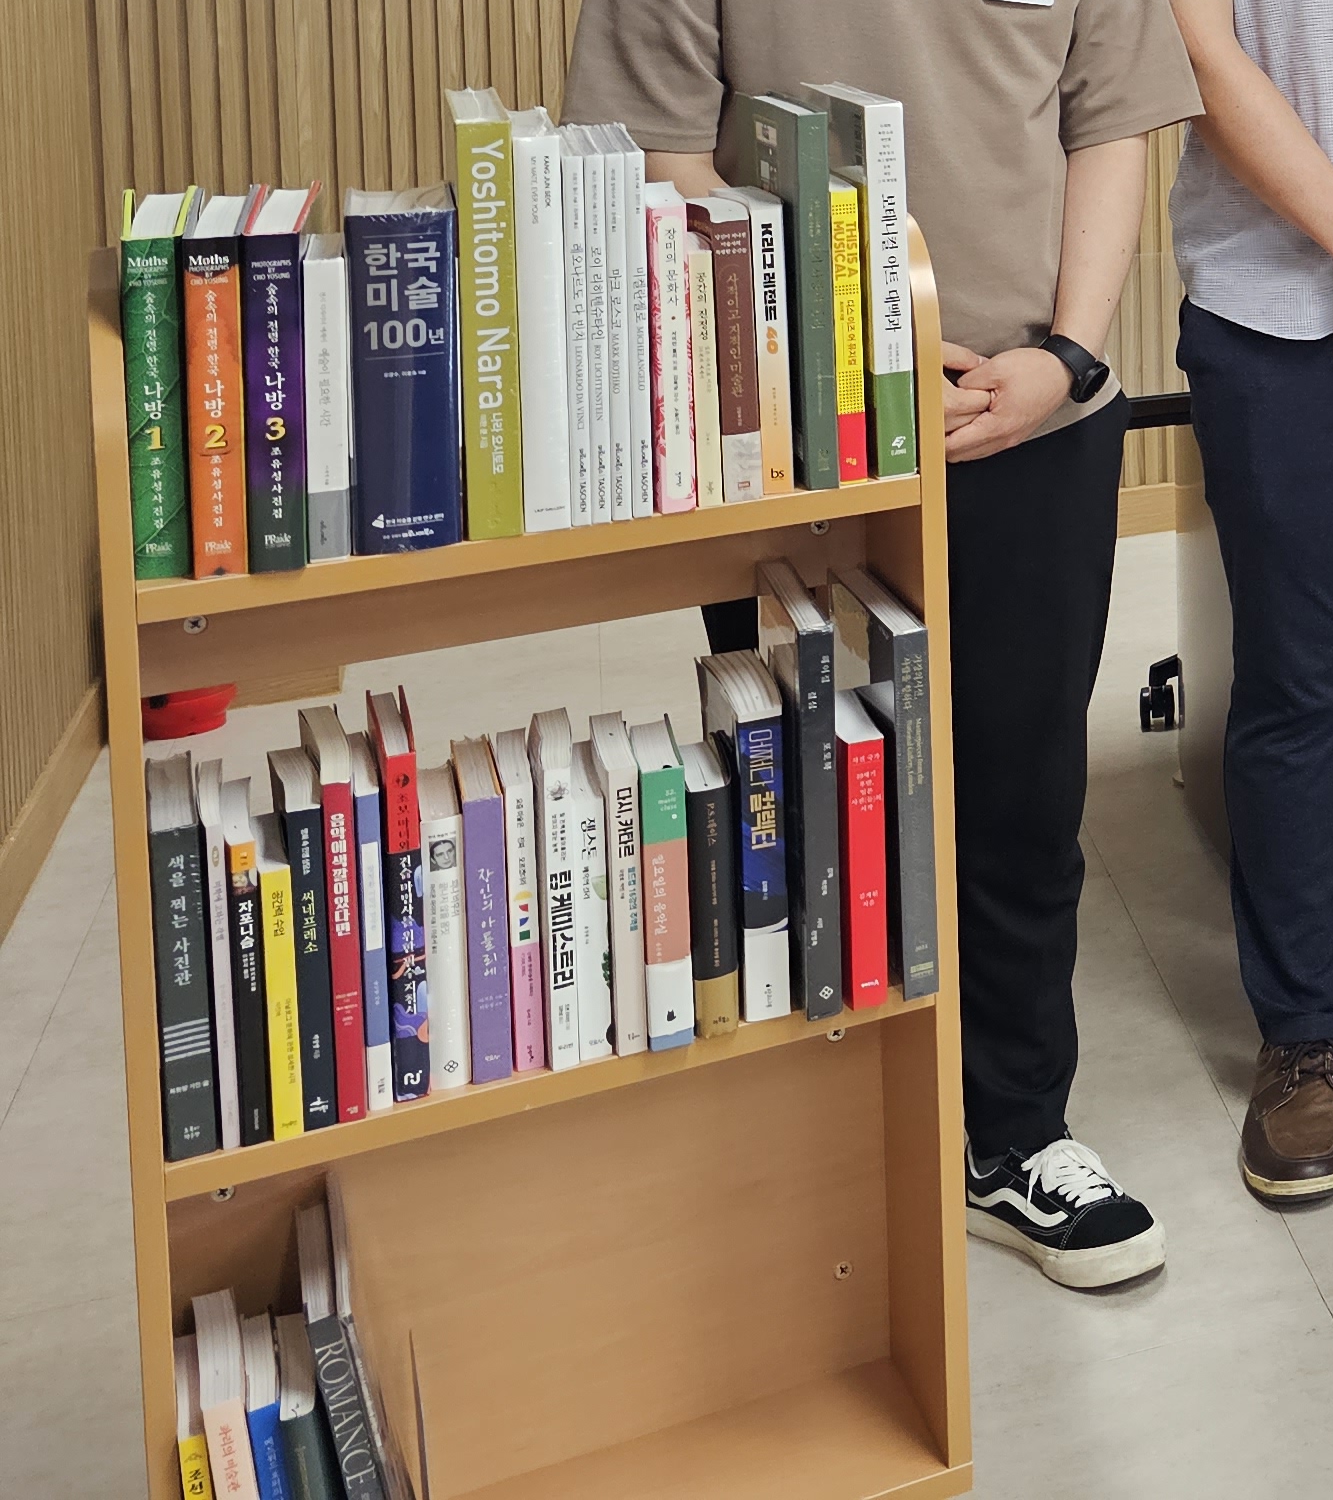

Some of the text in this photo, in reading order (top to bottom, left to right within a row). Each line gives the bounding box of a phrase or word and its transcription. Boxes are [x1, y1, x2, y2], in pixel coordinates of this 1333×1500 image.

[881, 193, 898, 252] 보태니컬
[127, 255, 169, 268] Moths
[188, 254, 230, 267] Moths
[364, 241, 441, 276] 한국
[590, 246, 602, 268] 로이
[665, 228, 679, 306] 장미의 문화사
[834, 221, 847, 281] MUSICAL
[846, 221, 858, 278] THIS IS A
[471, 138, 511, 410] Yoshitomo Nara
[570, 243, 584, 299] 레오나르도
[761, 223, 778, 355] K리그 레전드 40
[883, 256, 899, 285] 아트
[366, 276, 442, 312] 미술
[572, 304, 584, 314] 다
[590, 274, 604, 340] 리히텐슈타인
[609, 269, 622, 330] 마크 로스코
[633, 267, 646, 323] 미켈란젤로
[726, 273, 741, 320] 사적이고
[884, 290, 902, 332] 대백과
[363, 318, 445, 350] 100년
[572, 320, 585, 341] 빈치
[612, 334, 620, 358] MARK
[575, 346, 584, 392] LEONARDO
[594, 345, 602, 360] ROY
[636, 326, 645, 391] MICHELANGELO
[144, 382, 165, 420] 나방
[204, 380, 225, 418] 나방
[265, 372, 286, 411] 나방
[576, 393, 584, 405] DA
[144, 425, 166, 451] 1
[204, 423, 228, 449] 2
[265, 417, 286, 441] 3
[491, 412, 504, 475] 나라 요시토모
[579, 481, 587, 513] TASCHEN
[597, 477, 606, 510] TASCHEN
[615, 475, 623, 507] TASCHEN
[640, 472, 648, 503] TASCHEN
[749, 729, 776, 850] 어쩌다 컬렉터
[330, 813, 347, 853] 음악에
[550, 869, 572, 890] 팀
[167, 854, 192, 986] 색을 찍는 사진관
[238, 899, 254, 950] 자포니슴
[272, 891, 286, 937] 공간력 수업
[301, 890, 318, 954] 씨네프레소
[334, 894, 351, 937] 있다면
[478, 869, 497, 976] 장인의 아틀리에
[551, 892, 574, 991] 케미스트리
[315, 1338, 377, 1490] ROMANCE
[224, 1459, 242, 1493] 미술관
